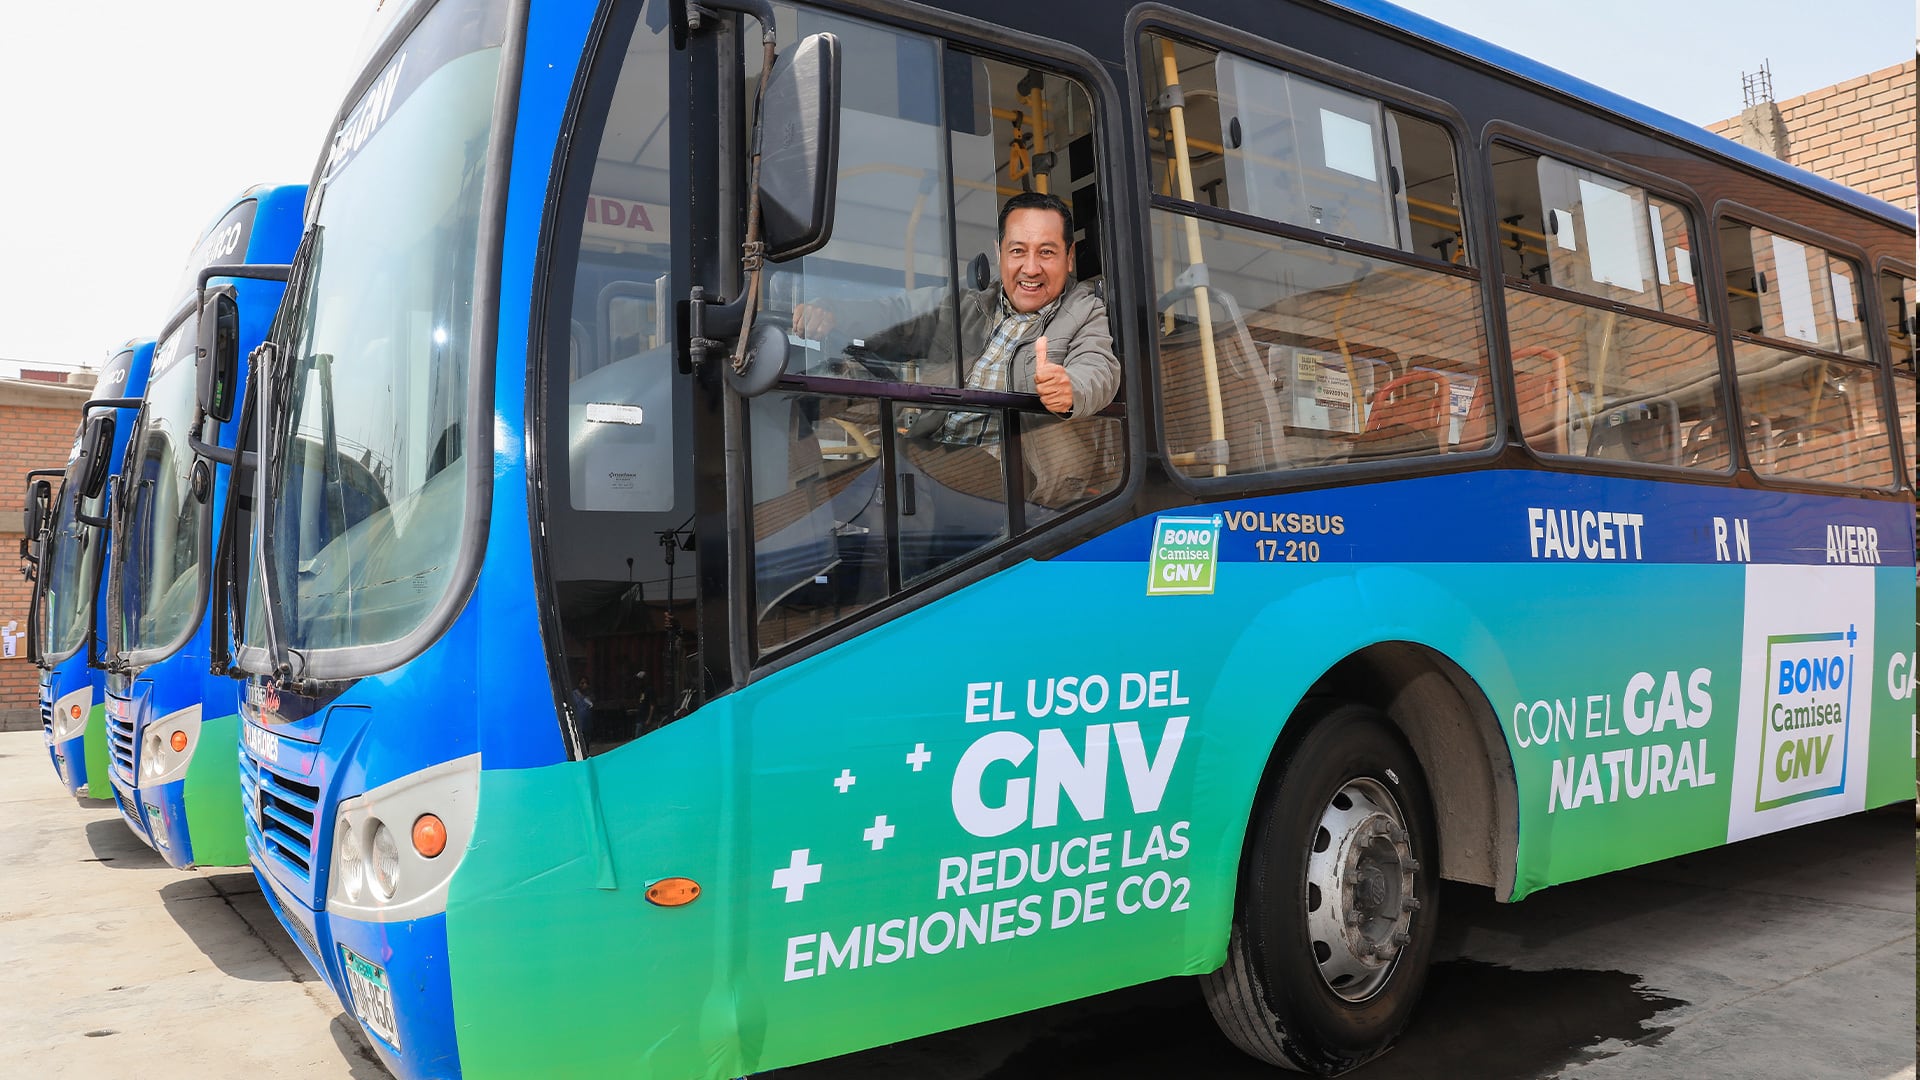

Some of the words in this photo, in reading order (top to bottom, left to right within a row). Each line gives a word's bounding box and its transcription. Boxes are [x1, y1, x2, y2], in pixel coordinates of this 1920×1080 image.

[1163, 529, 1211, 546] BONO
[1223, 510, 1345, 535] VOLKSBUS
[1527, 507, 1644, 560] FAUCETT
[1826, 524, 1881, 564] AVERR
[1158, 547, 1209, 561] Camisea
[1162, 563, 1203, 582] GNV
[1255, 539, 1320, 562] 17-210
[965, 681, 1015, 723] EL
[1027, 674, 1109, 717] USO
[1120, 670, 1189, 710] DEL
[1778, 655, 1845, 695] BONO
[1513, 697, 1576, 748] CON
[1585, 694, 1620, 738] EL
[1623, 667, 1713, 736] GAS
[1771, 697, 1842, 732] Camisea
[952, 716, 1190, 838] GNV
[1548, 738, 1716, 814] NATURAL
[1775, 734, 1834, 783] GNV
[937, 832, 1112, 900] REDUCE
[1121, 821, 1190, 868] LAS
[784, 895, 1041, 982] EMISIONES
[1051, 882, 1107, 930] DE
[1116, 871, 1191, 916] CO2
